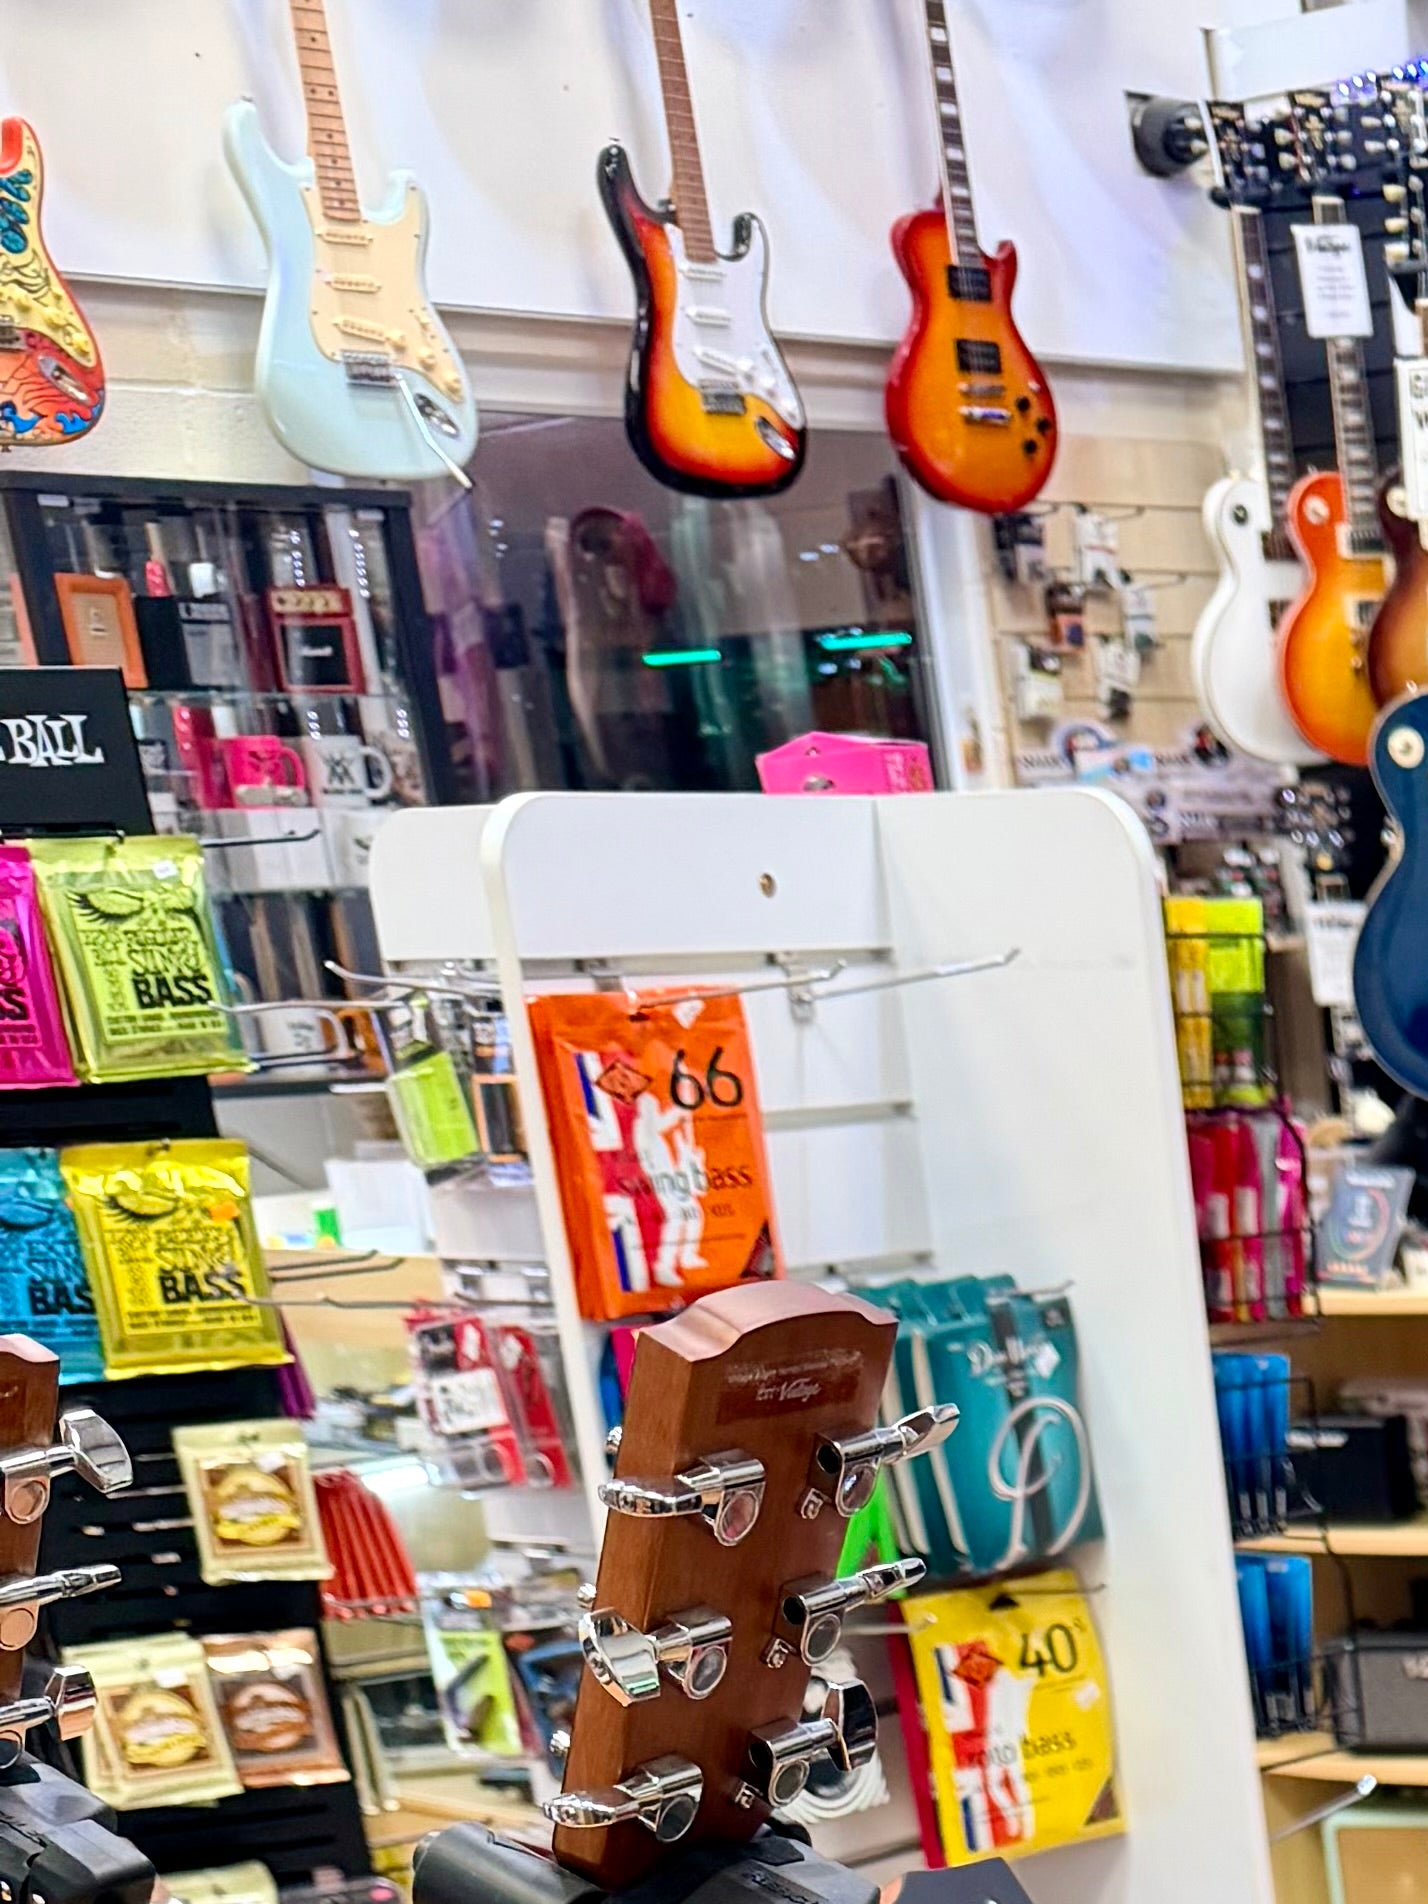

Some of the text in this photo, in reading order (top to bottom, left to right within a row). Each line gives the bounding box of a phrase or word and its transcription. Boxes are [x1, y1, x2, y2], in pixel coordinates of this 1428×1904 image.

[2, 714, 105, 767] BALL
[131, 973, 212, 1009] BASS
[670, 1046, 744, 1110] 66
[159, 1268, 248, 1304] BASS
